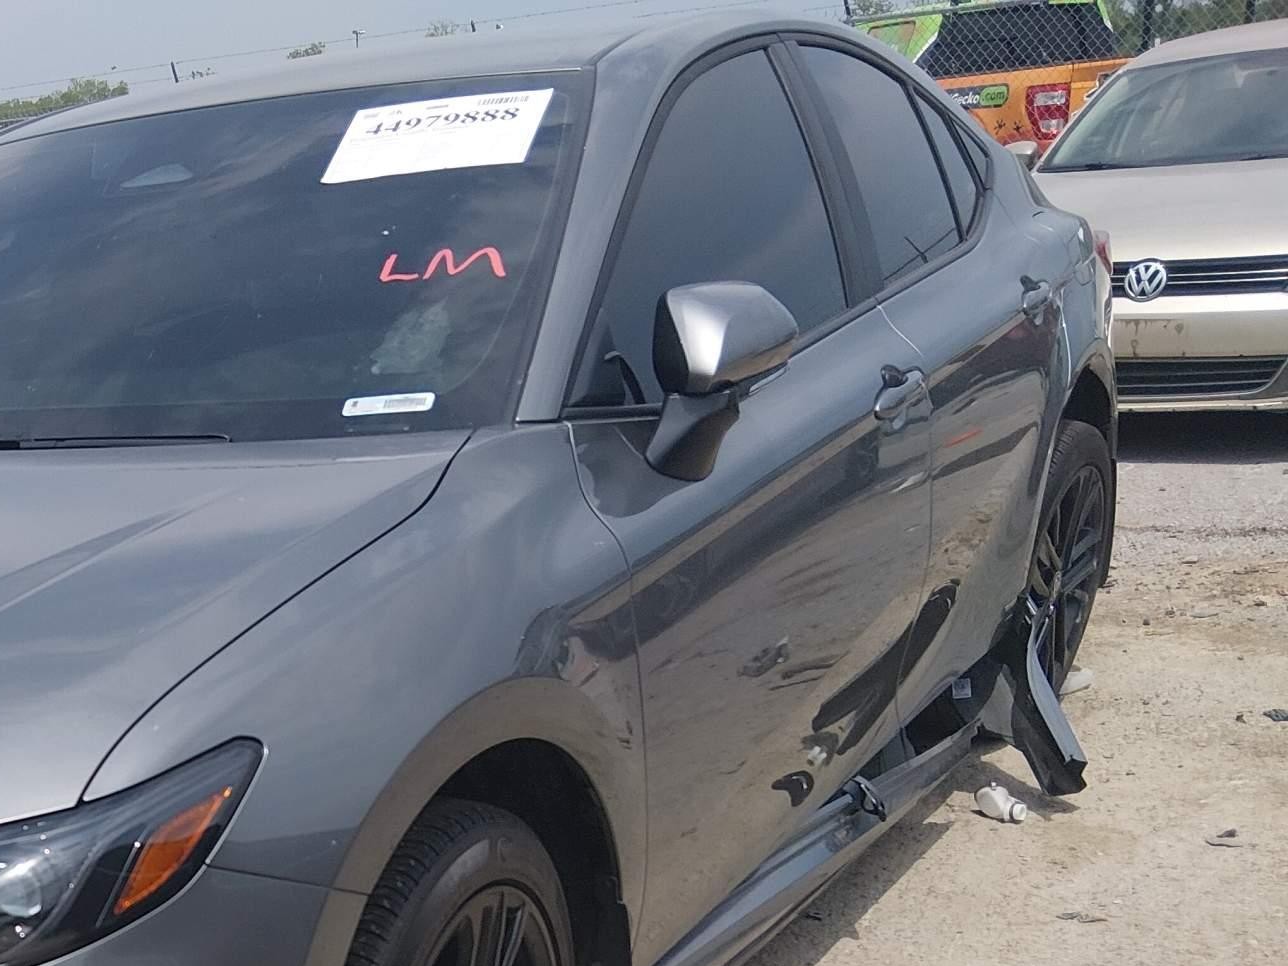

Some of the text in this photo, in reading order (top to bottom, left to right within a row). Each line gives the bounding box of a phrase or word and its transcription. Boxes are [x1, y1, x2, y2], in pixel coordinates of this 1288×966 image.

[951, 91, 1005, 105] Gecko.com
[366, 107, 520, 135] 44979888
[379, 247, 506, 282] LM
[1125, 261, 1167, 302] VW
